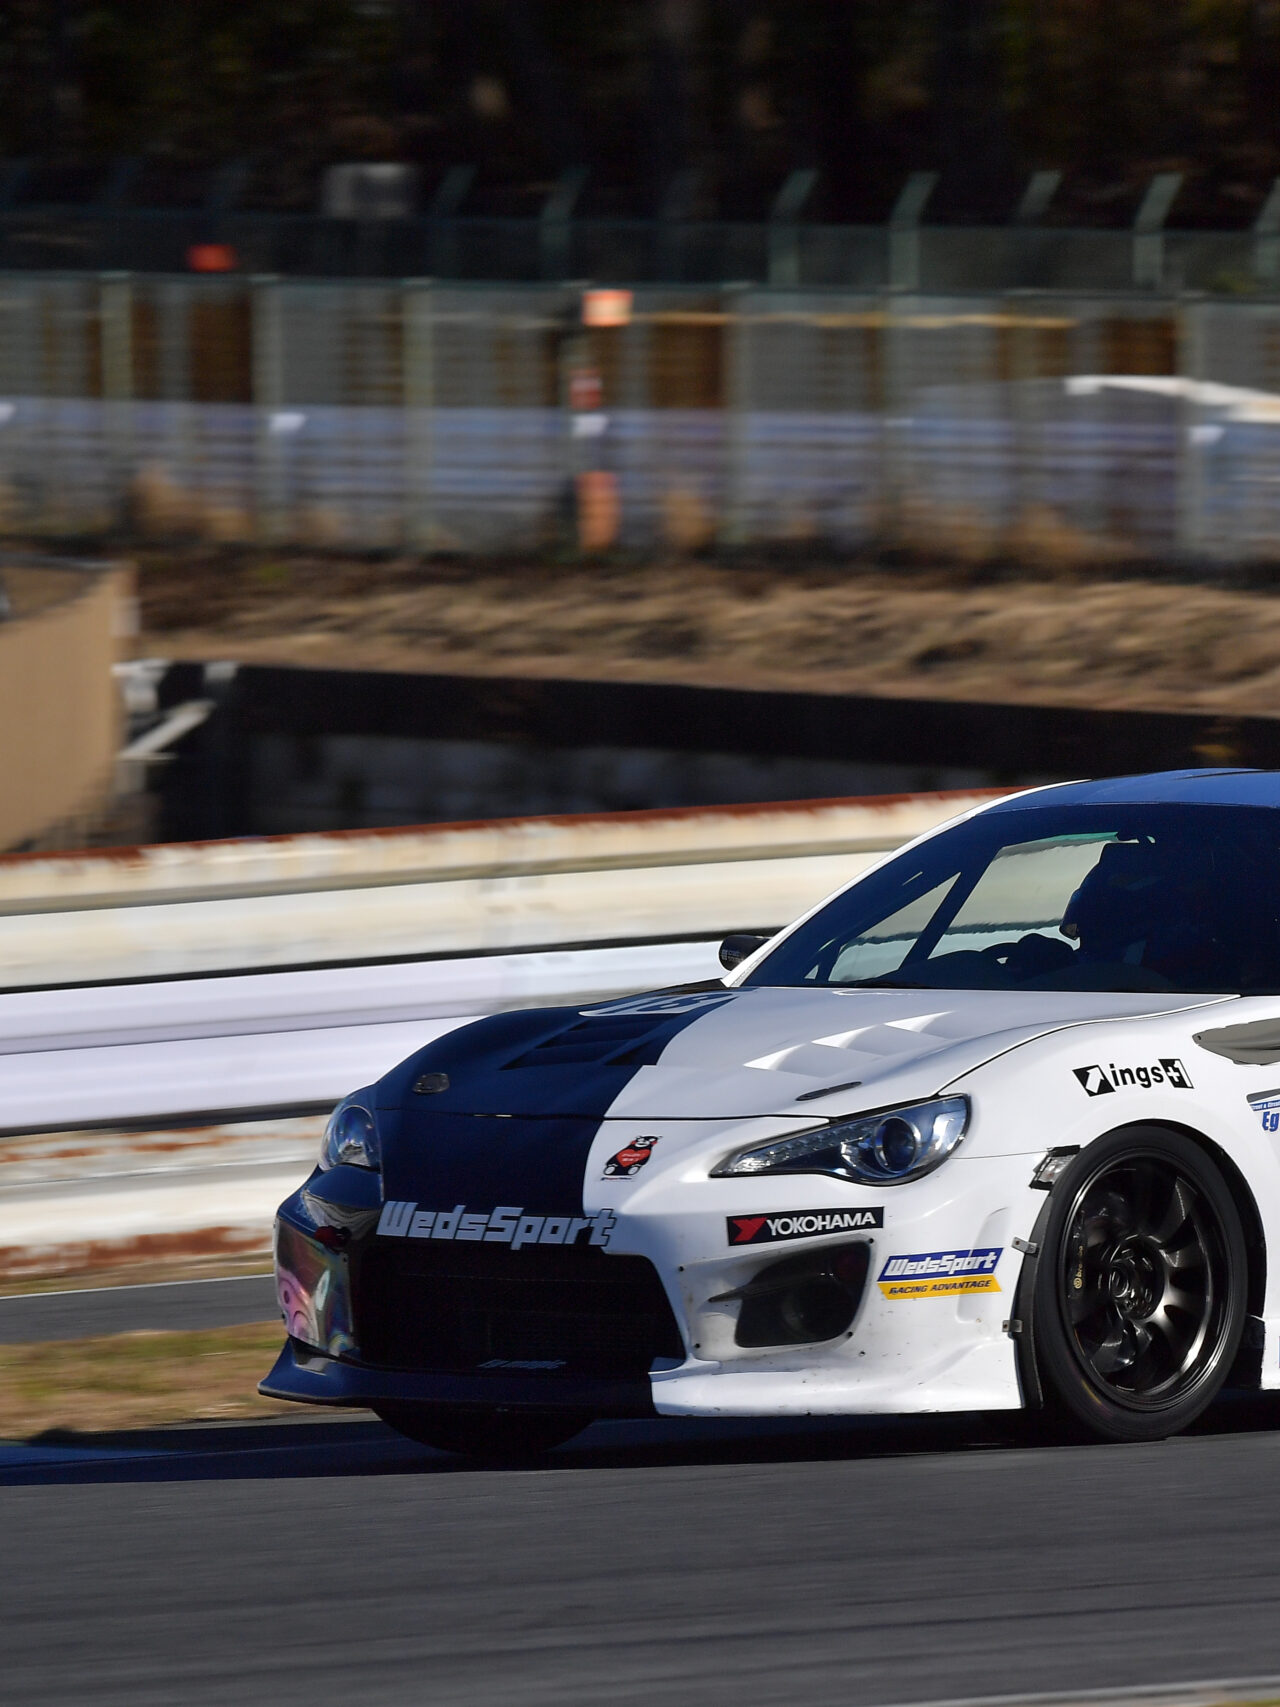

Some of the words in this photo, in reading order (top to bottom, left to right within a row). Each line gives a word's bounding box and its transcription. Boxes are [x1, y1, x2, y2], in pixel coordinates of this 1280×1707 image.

[1262, 1111, 1280, 1132] Eg
[376, 1200, 617, 1251] WedsSport
[766, 1211, 876, 1237] YOKOHAMA
[881, 1252, 999, 1277] WedsSport
[888, 1284, 930, 1295] RACING
[931, 1279, 993, 1292] ADVANTAGE
